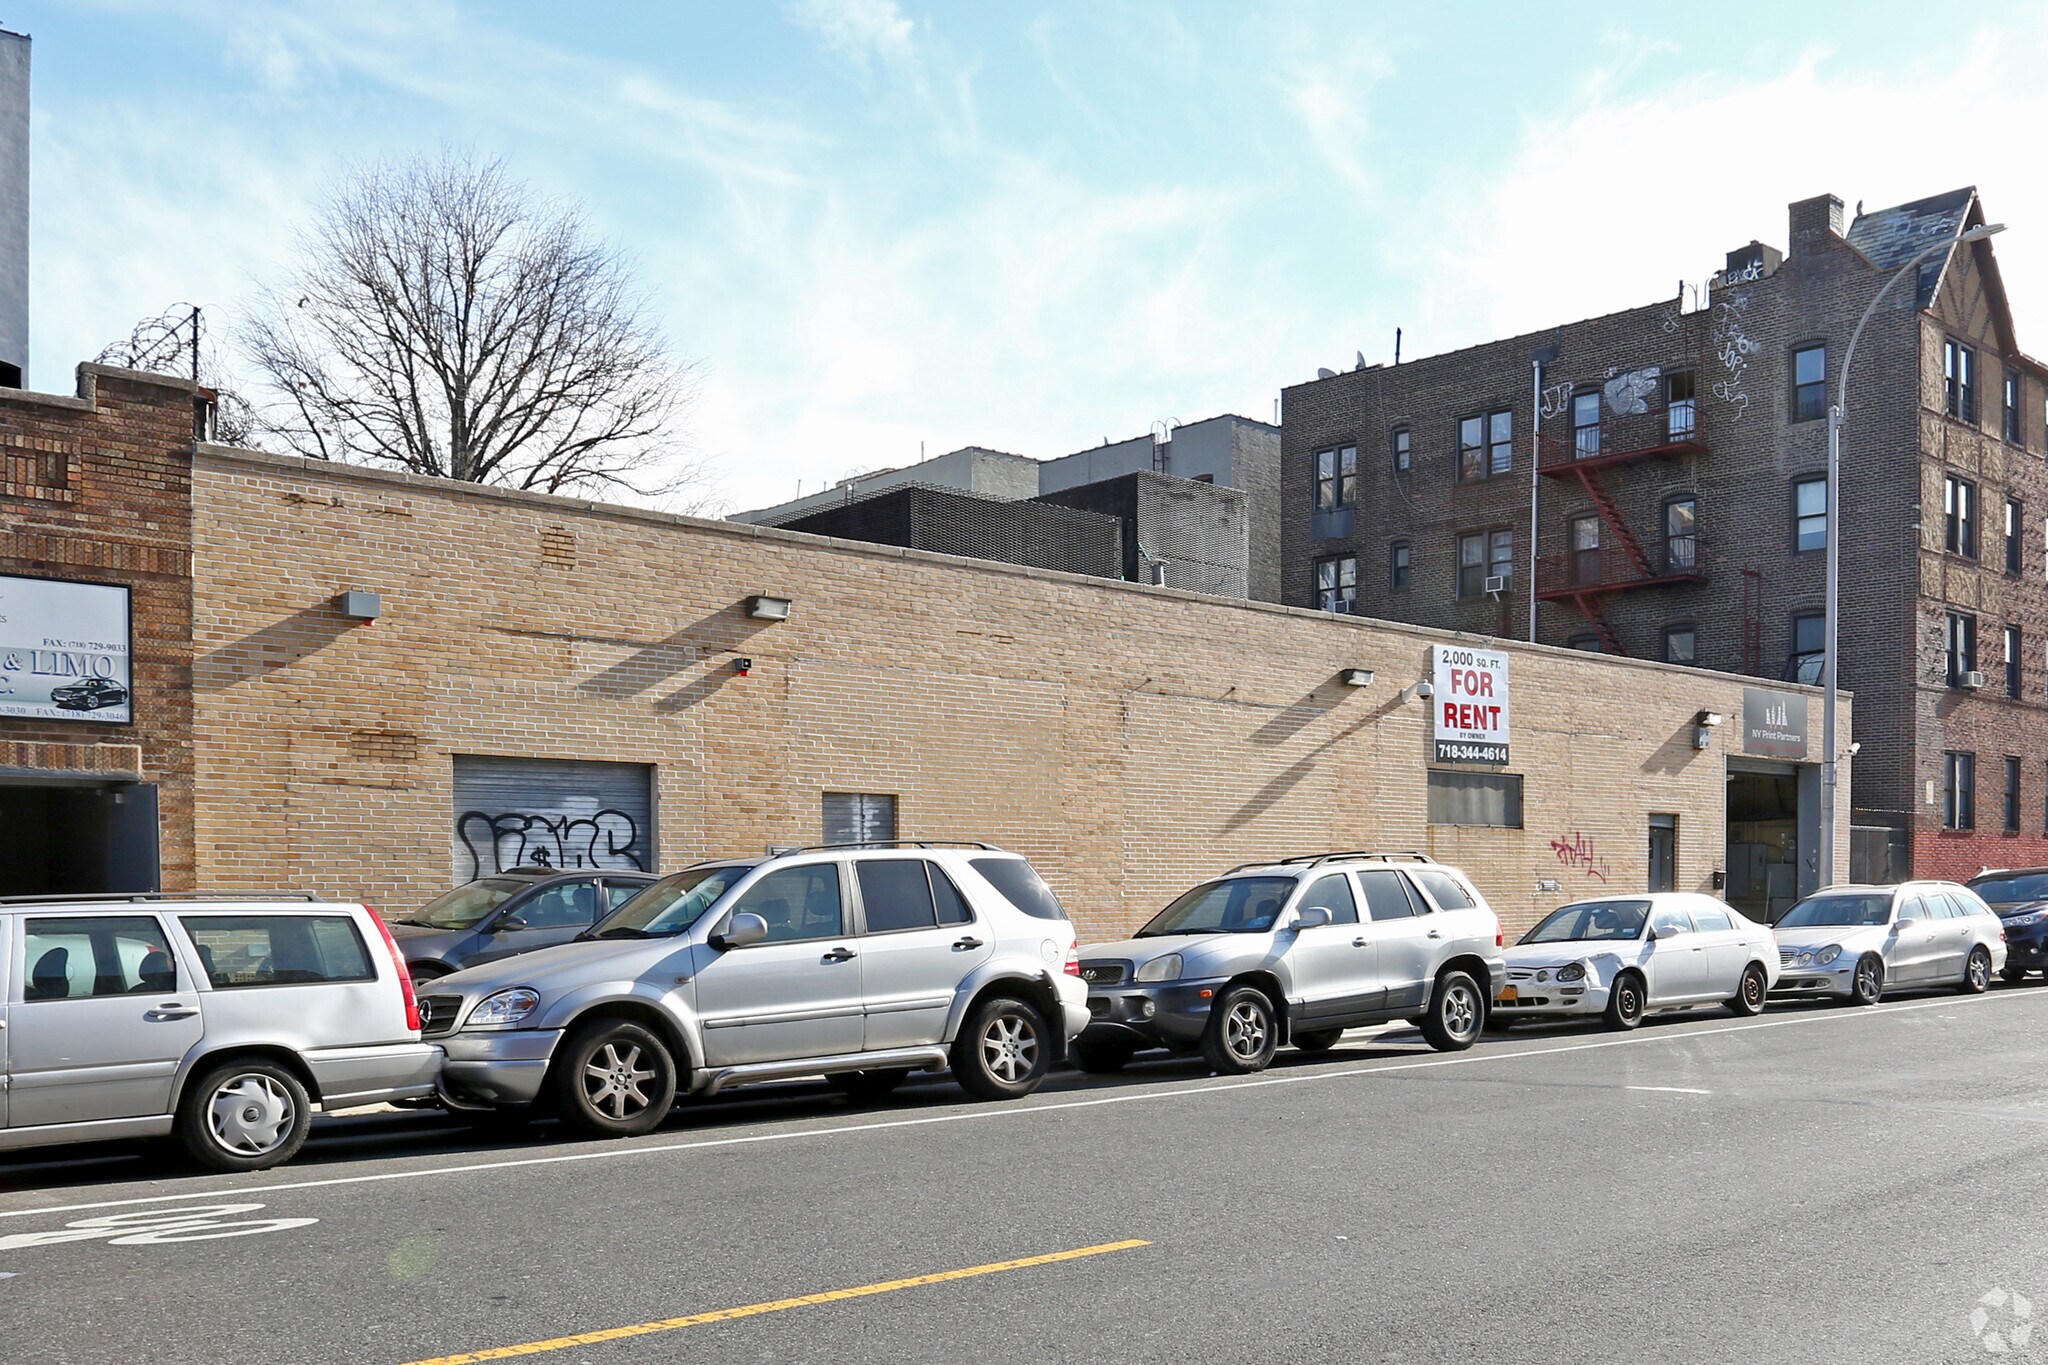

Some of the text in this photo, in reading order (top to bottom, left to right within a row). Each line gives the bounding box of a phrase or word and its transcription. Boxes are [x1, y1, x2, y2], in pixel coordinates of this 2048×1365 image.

[43, 638, 126, 652] FAX: (718) 729-9033
[3, 650, 117, 679] & LIMO
[1442, 650, 1501, 669] 2,000 SQ. FT.
[1451, 669, 1494, 697] FOR
[36, 708, 59, 717] FAX:
[87, 710, 125, 720] 729-3046
[1444, 702, 1501, 731] RENT
[1752, 729, 1801, 742] NY Print Partners
[1439, 744, 1507, 761] 718-344-4614
